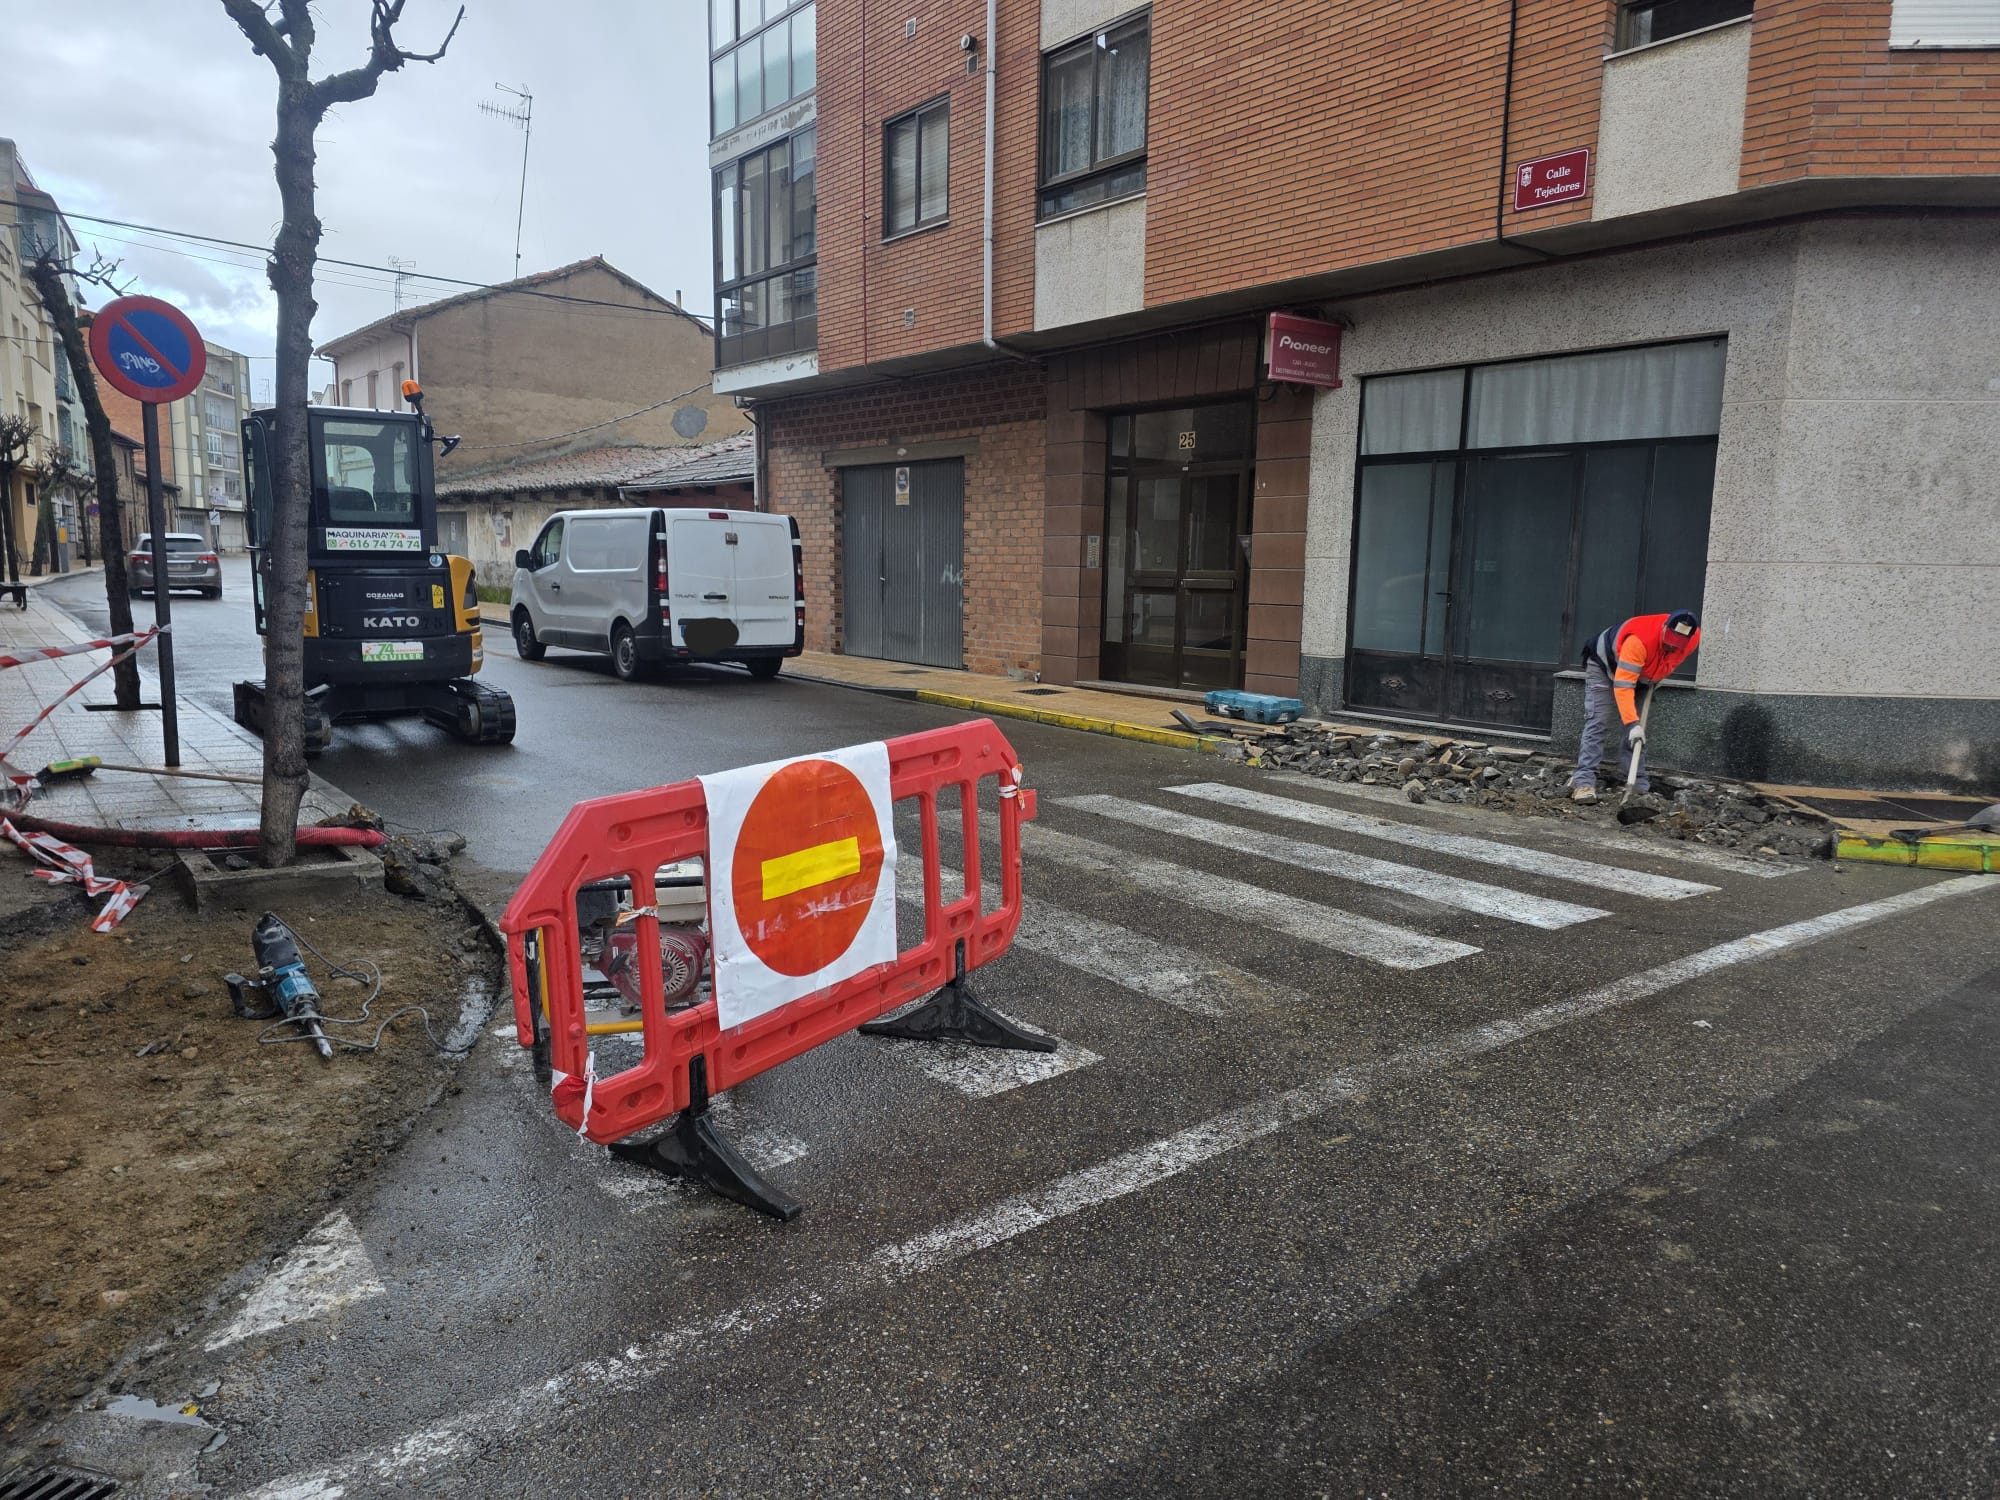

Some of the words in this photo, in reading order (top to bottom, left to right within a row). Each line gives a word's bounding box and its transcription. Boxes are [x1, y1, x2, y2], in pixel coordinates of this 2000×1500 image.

[1546, 166, 1571, 179] Calle
[1535, 182, 1580, 198] Tejedores
[1279, 335, 1331, 354] Pioneer
[1180, 432, 1195, 448] 25
[349, 540, 370, 549] 616
[374, 540, 387, 549] 74
[390, 540, 403, 549] 74
[406, 540, 420, 549] 74
[363, 616, 420, 628] KATO
[365, 653, 422, 661] ALQUILER
